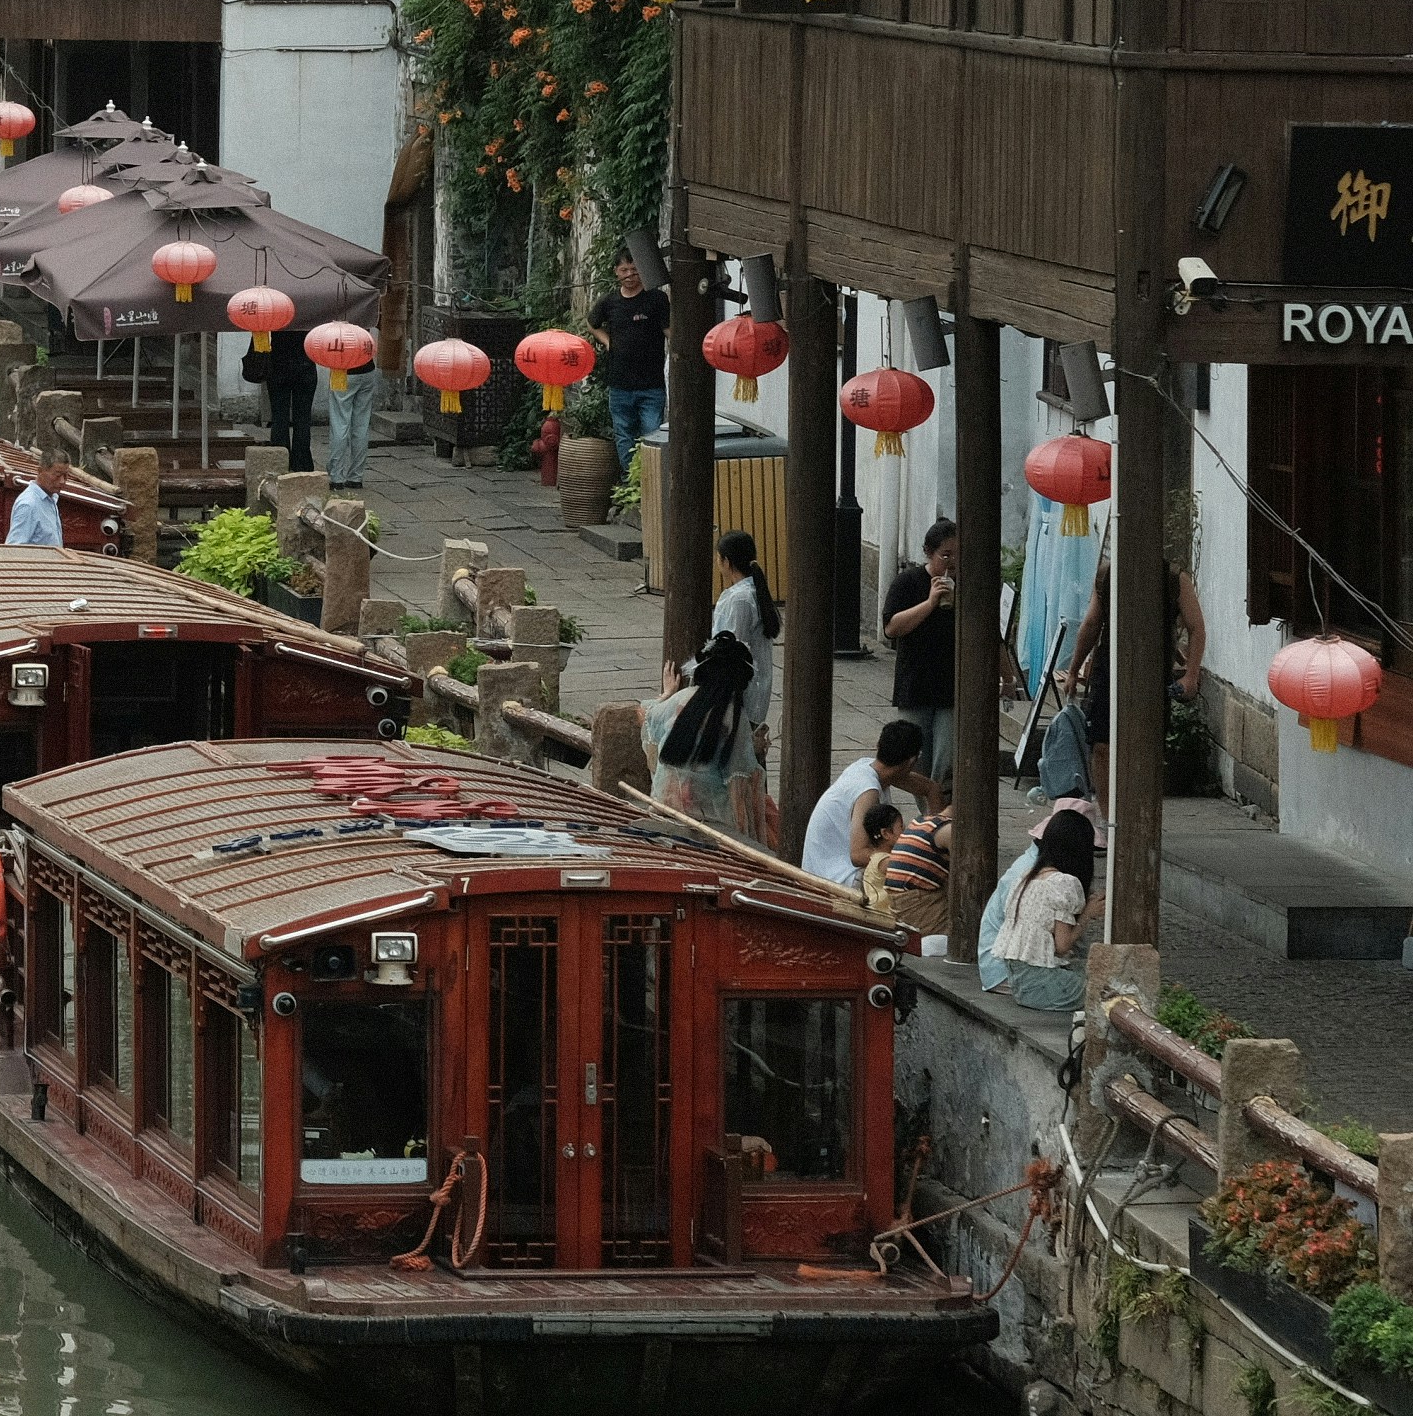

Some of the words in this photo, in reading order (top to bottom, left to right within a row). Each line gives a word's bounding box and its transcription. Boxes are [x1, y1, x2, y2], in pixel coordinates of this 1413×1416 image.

[1330, 168, 1392, 243] 御
[241, 301, 257, 316] 塘
[1283, 303, 1413, 344] ROYA
[524, 347, 579, 367] 山塘
[849, 387, 871, 409] 塘
[460, 877, 470, 894] 7
